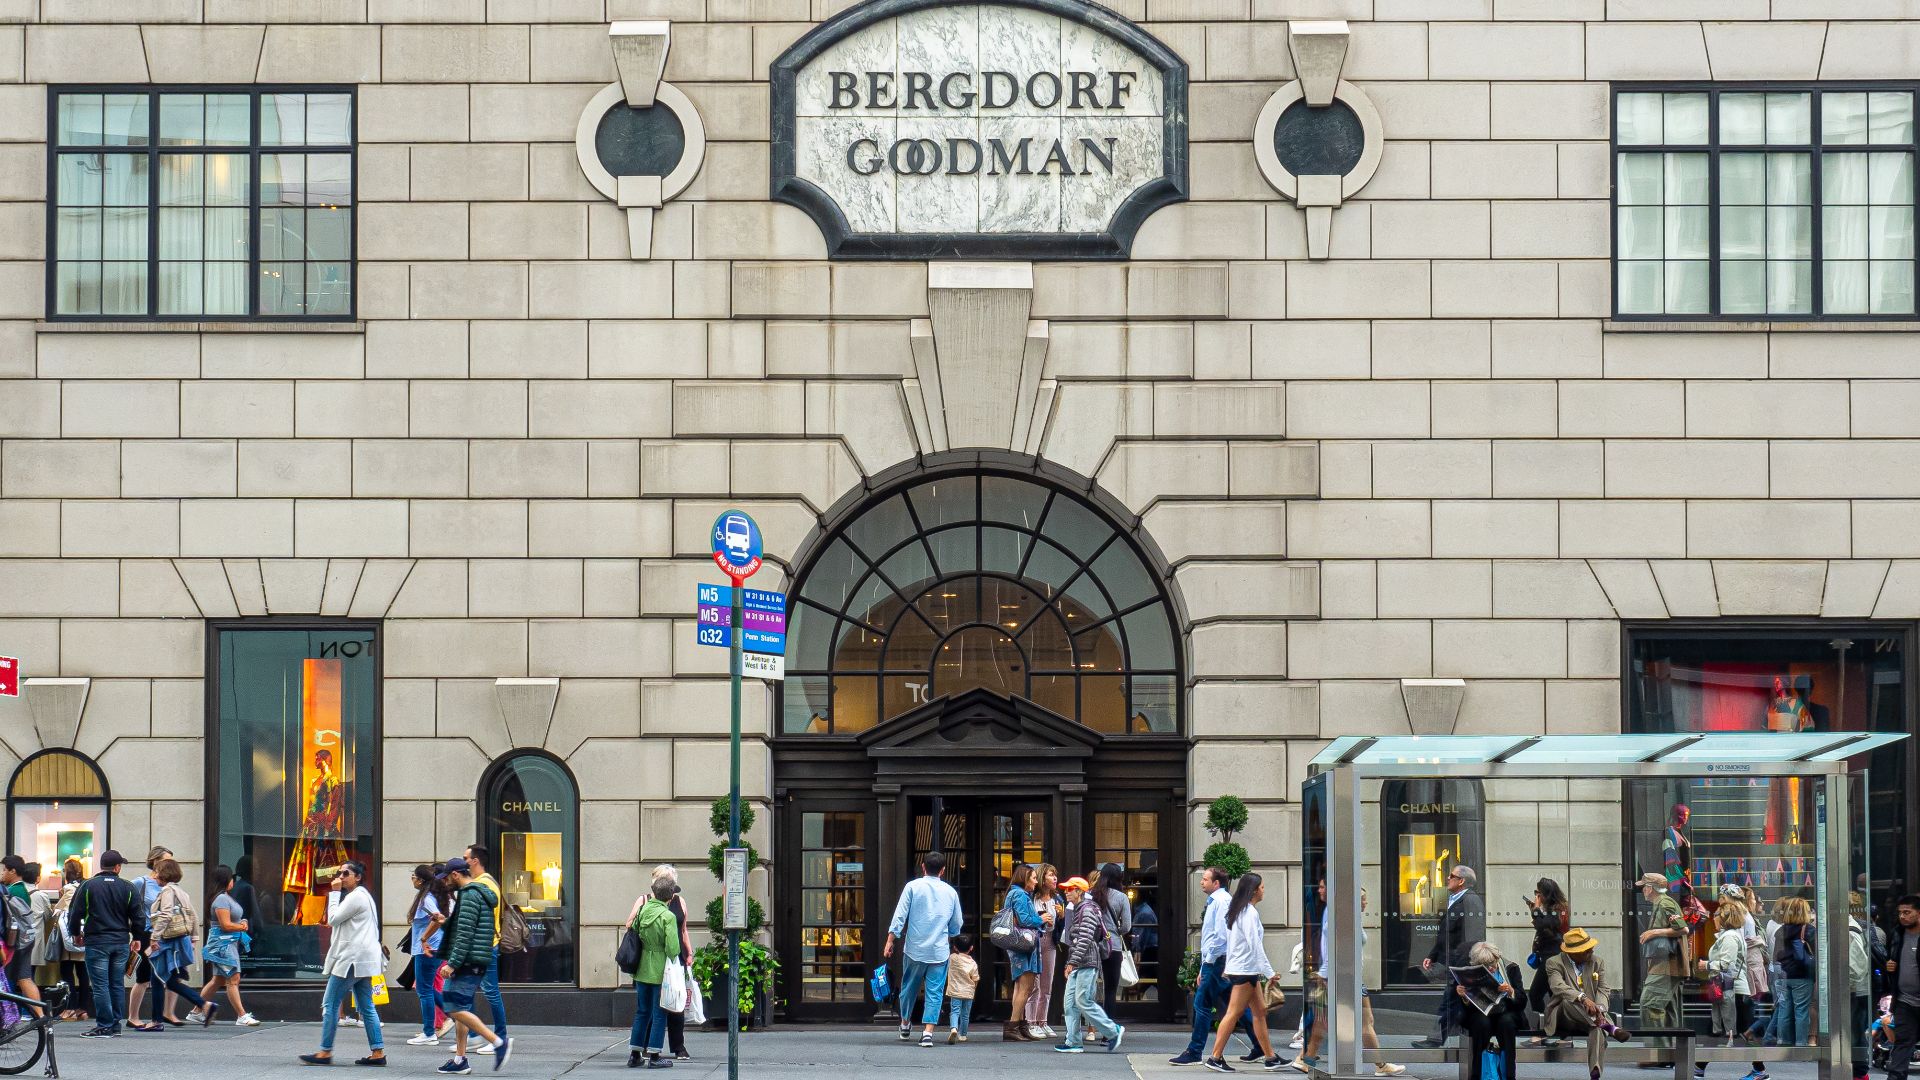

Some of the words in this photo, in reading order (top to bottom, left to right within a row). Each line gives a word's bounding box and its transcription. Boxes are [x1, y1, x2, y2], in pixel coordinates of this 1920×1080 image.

[828, 71, 1137, 109] BERGDORF
[846, 137, 1118, 176] GOODMAN
[717, 554, 728, 567] NO
[727, 558, 759, 575] STANDING
[700, 587, 719, 603] M5
[701, 608, 719, 623] M5
[700, 629, 723, 644] Q32
[745, 633, 759, 641] Penn
[760, 635, 780, 643] Station
[745, 662, 759, 670] West
[751, 655, 770, 663] Avenue
[502, 801, 562, 812] CHANEL
[1400, 803, 1459, 813] CHANEL
